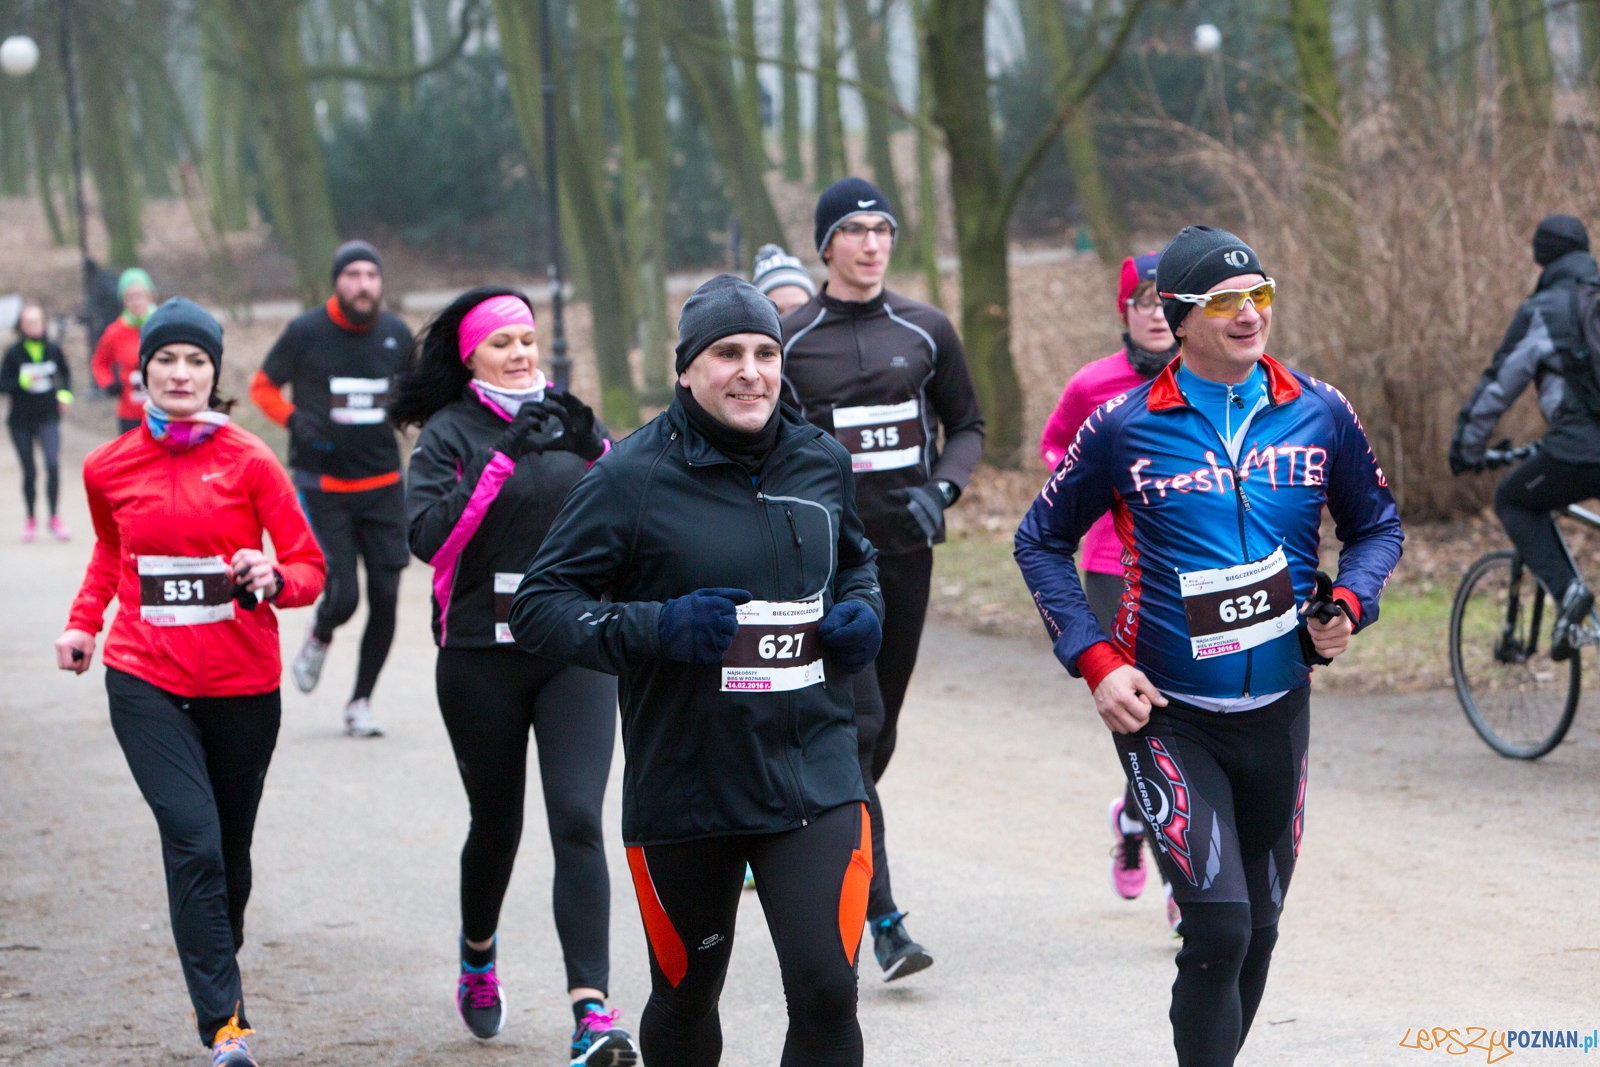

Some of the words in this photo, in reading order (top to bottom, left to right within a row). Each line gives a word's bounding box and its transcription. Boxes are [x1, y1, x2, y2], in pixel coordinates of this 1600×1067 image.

[860, 426, 899, 449] 315
[163, 579, 204, 601] 531
[1219, 589, 1271, 623] 632
[758, 632, 805, 660] 627
[1128, 752, 1163, 841] ROLLERBLADE
